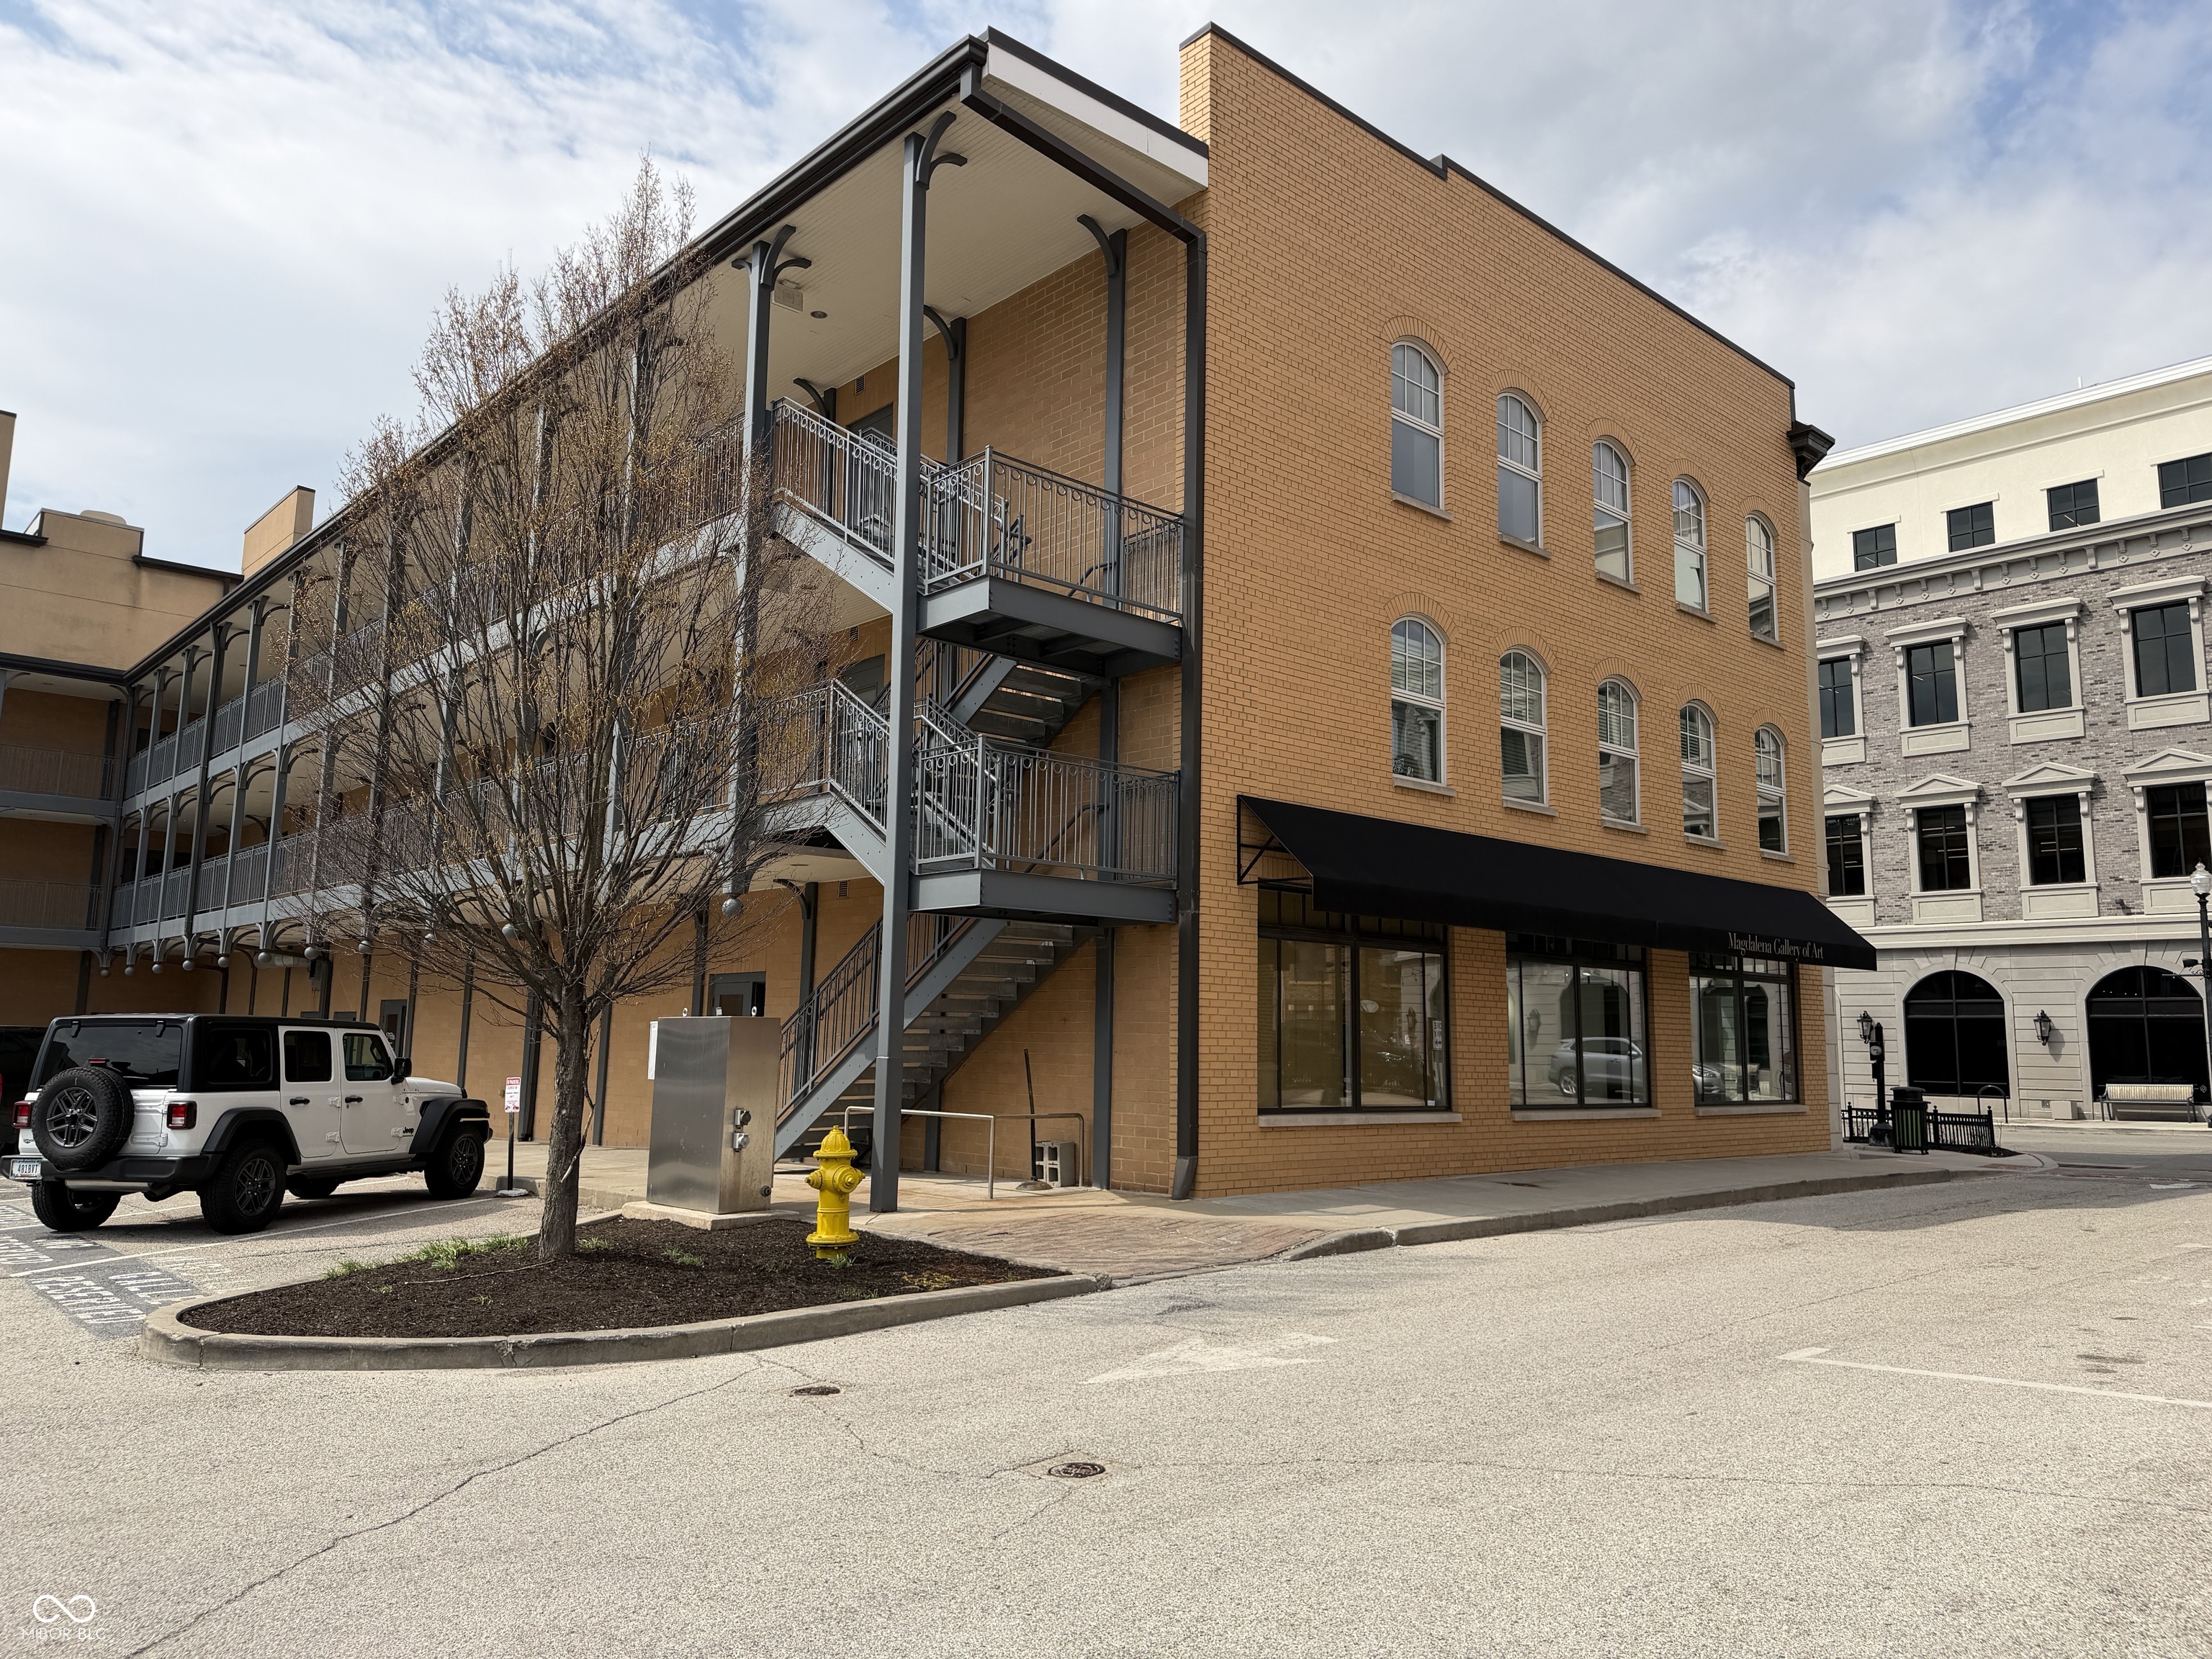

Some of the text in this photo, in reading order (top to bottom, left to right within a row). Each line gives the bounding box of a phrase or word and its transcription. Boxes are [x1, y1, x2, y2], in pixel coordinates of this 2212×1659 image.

[1728, 932, 1824, 962] Magdalena Gallery of Art
[28, 1275, 147, 1323] RESERVED
